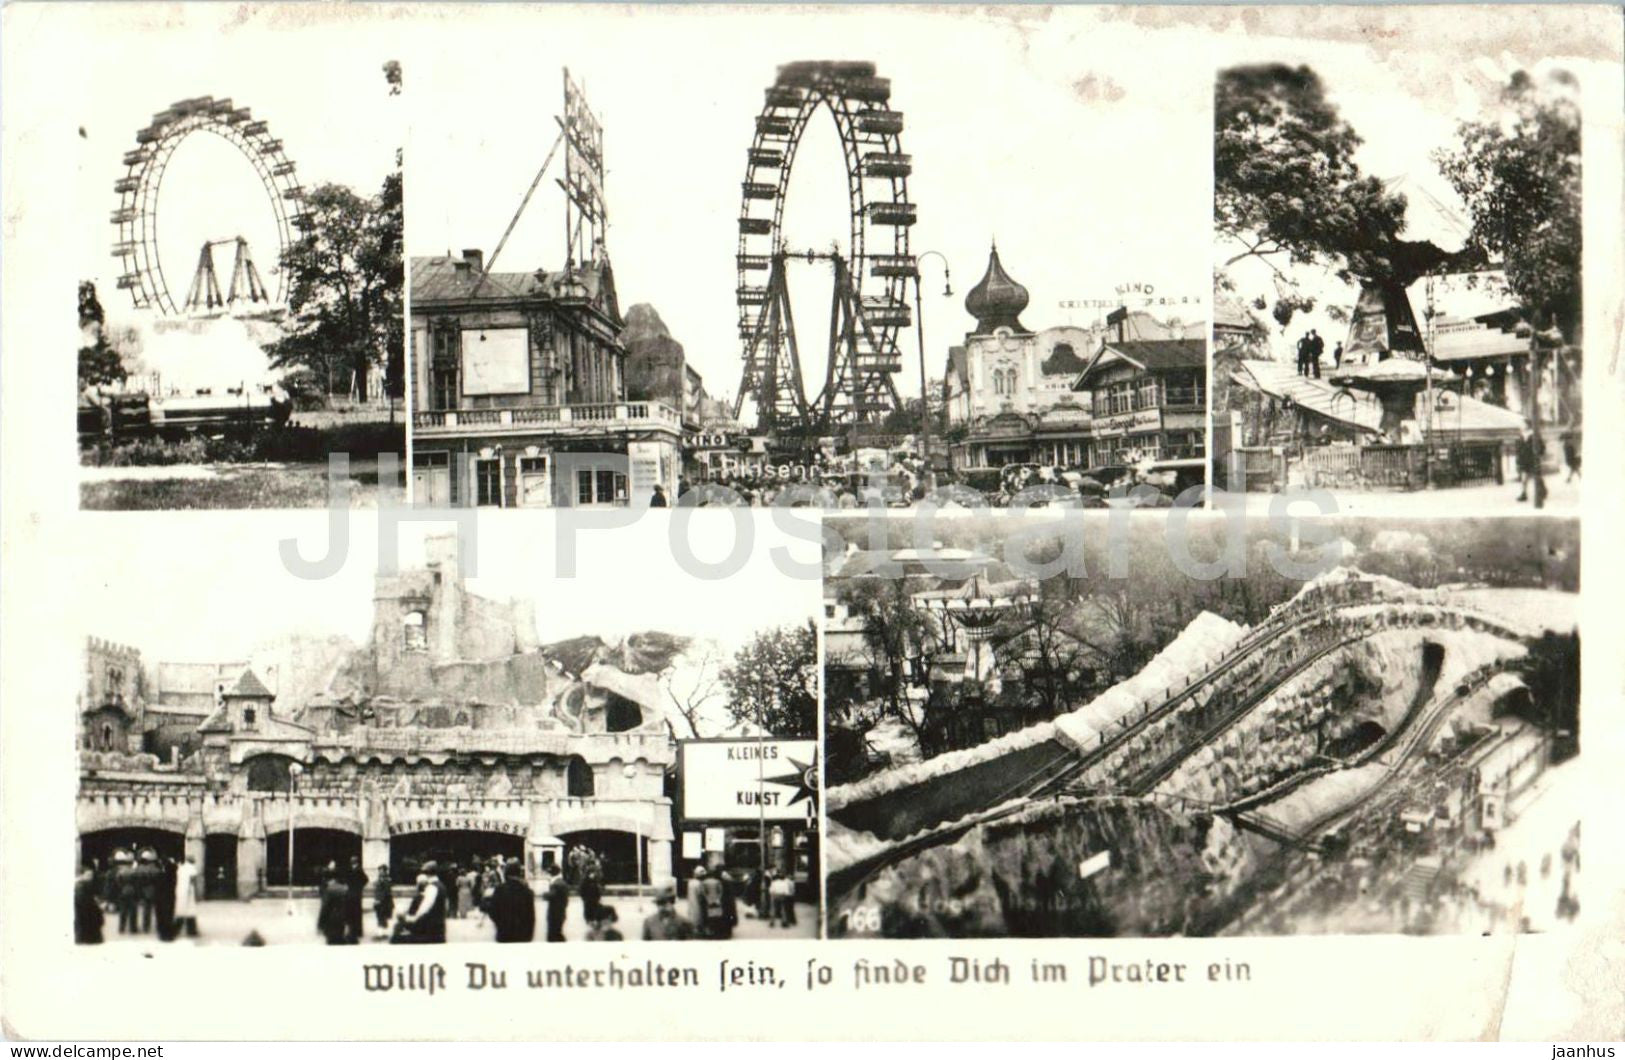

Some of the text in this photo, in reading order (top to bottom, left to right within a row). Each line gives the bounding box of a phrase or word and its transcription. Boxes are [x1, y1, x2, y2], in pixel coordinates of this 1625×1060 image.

[683, 434, 725, 448] KINO
[727, 746, 778, 760] KLEINES
[736, 791, 781, 805] KUNST
